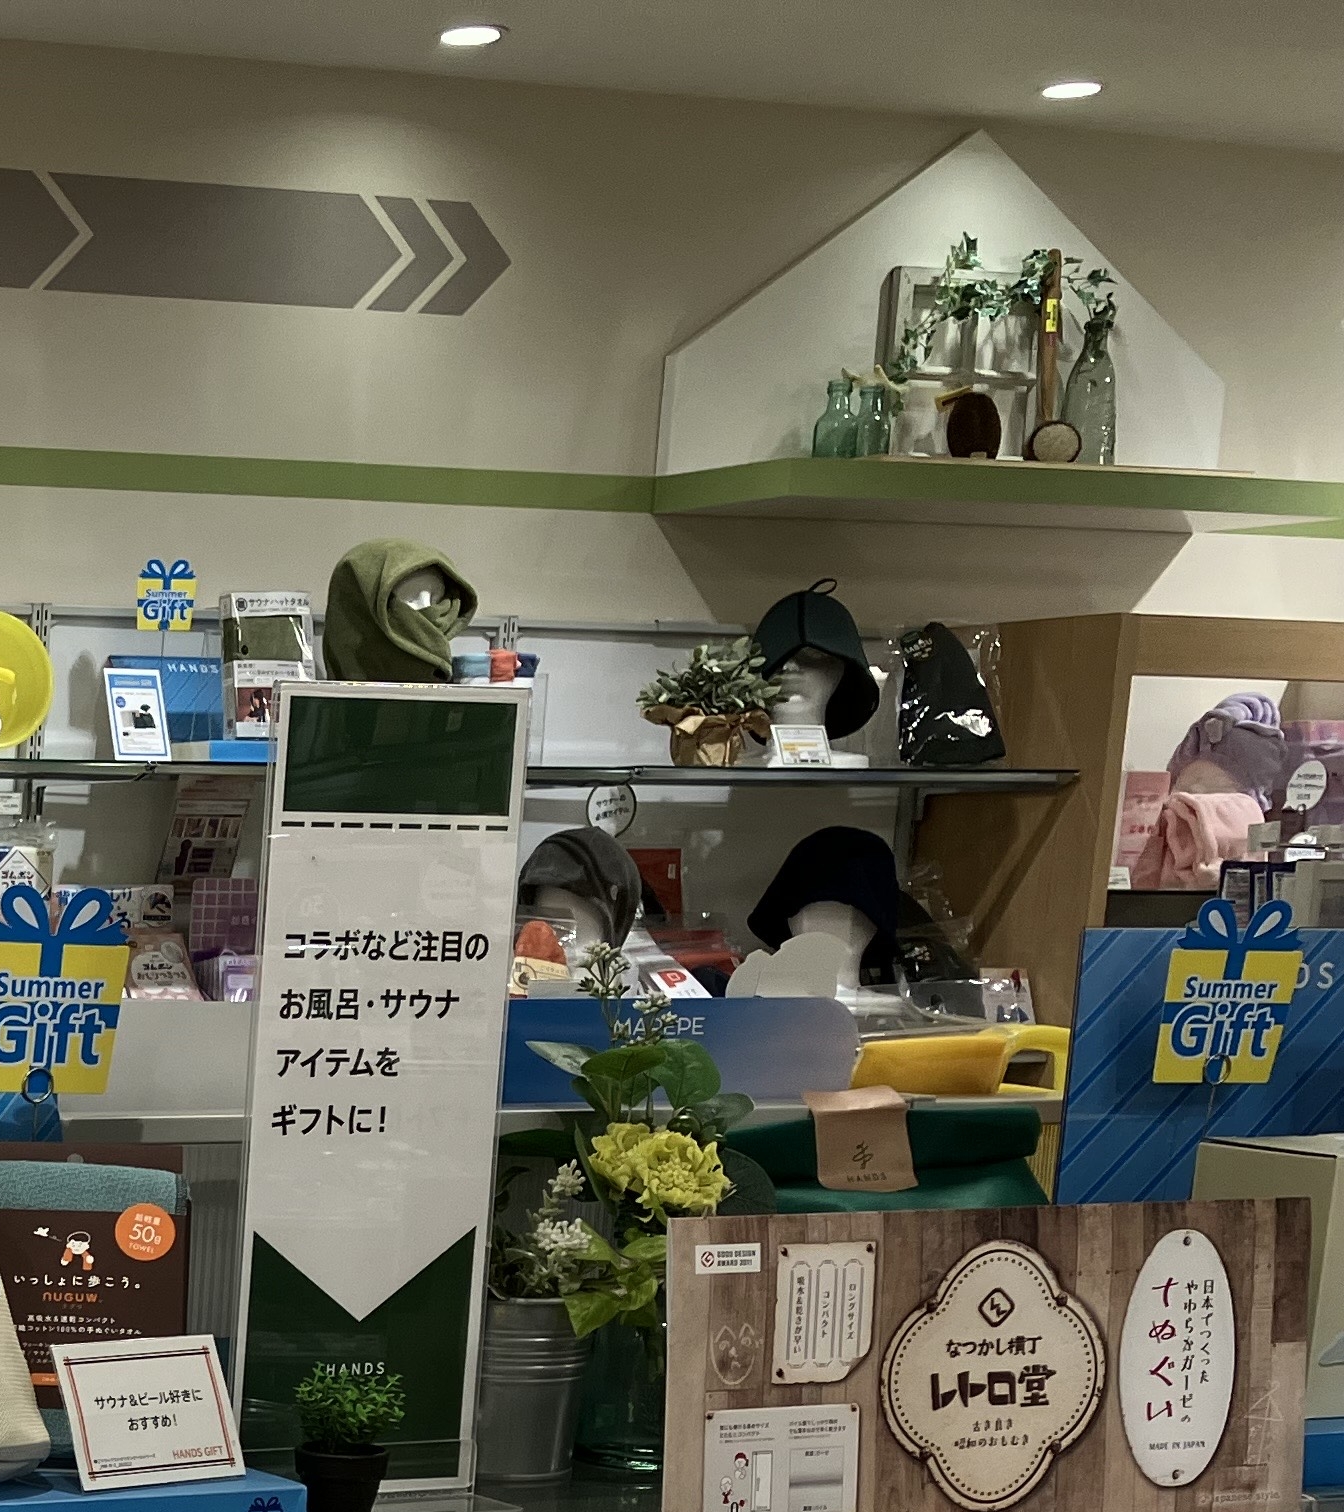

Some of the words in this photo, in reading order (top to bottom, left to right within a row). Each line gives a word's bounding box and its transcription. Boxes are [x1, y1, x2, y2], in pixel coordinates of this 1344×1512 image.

[145, 589, 188, 601] Summer
[142, 599, 188, 624] Gift
[167, 661, 219, 675] HANDS
[283, 929, 490, 964] コラボなど注目の
[1183, 974, 1278, 1002] Summer
[279, 987, 460, 1021] お風呂・サウナ
[1170, 1001, 1278, 1060] Gift
[275, 1046, 401, 1079] アイテムを
[270, 1104, 388, 1136] ギフトに！
[128, 1223, 162, 1244] 50g
[128, 1242, 155, 1255] TOWEL
[13, 1273, 143, 1290] いっしょに歩こう。
[821, 1290, 831, 1339] コンパクト
[846, 1282, 857, 1341] ロングサイズ
[1198, 1278, 1216, 1385] 日本でつくった
[945, 1335, 1043, 1358] なつかし横丁
[1179, 1279, 1199, 1424] やわらかガーゼの
[325, 1361, 387, 1377] HANDS
[93, 1387, 203, 1411] サウナ&ビール好きに
[930, 1364, 1057, 1411] レトロ堂
[127, 1416, 179, 1433] おすすめ！
[172, 1447, 203, 1461] HANDS
[203, 1446, 224, 1458] GIFT
[1149, 1441, 1171, 1451] MADE
[1182, 1440, 1206, 1450] JAPAN
